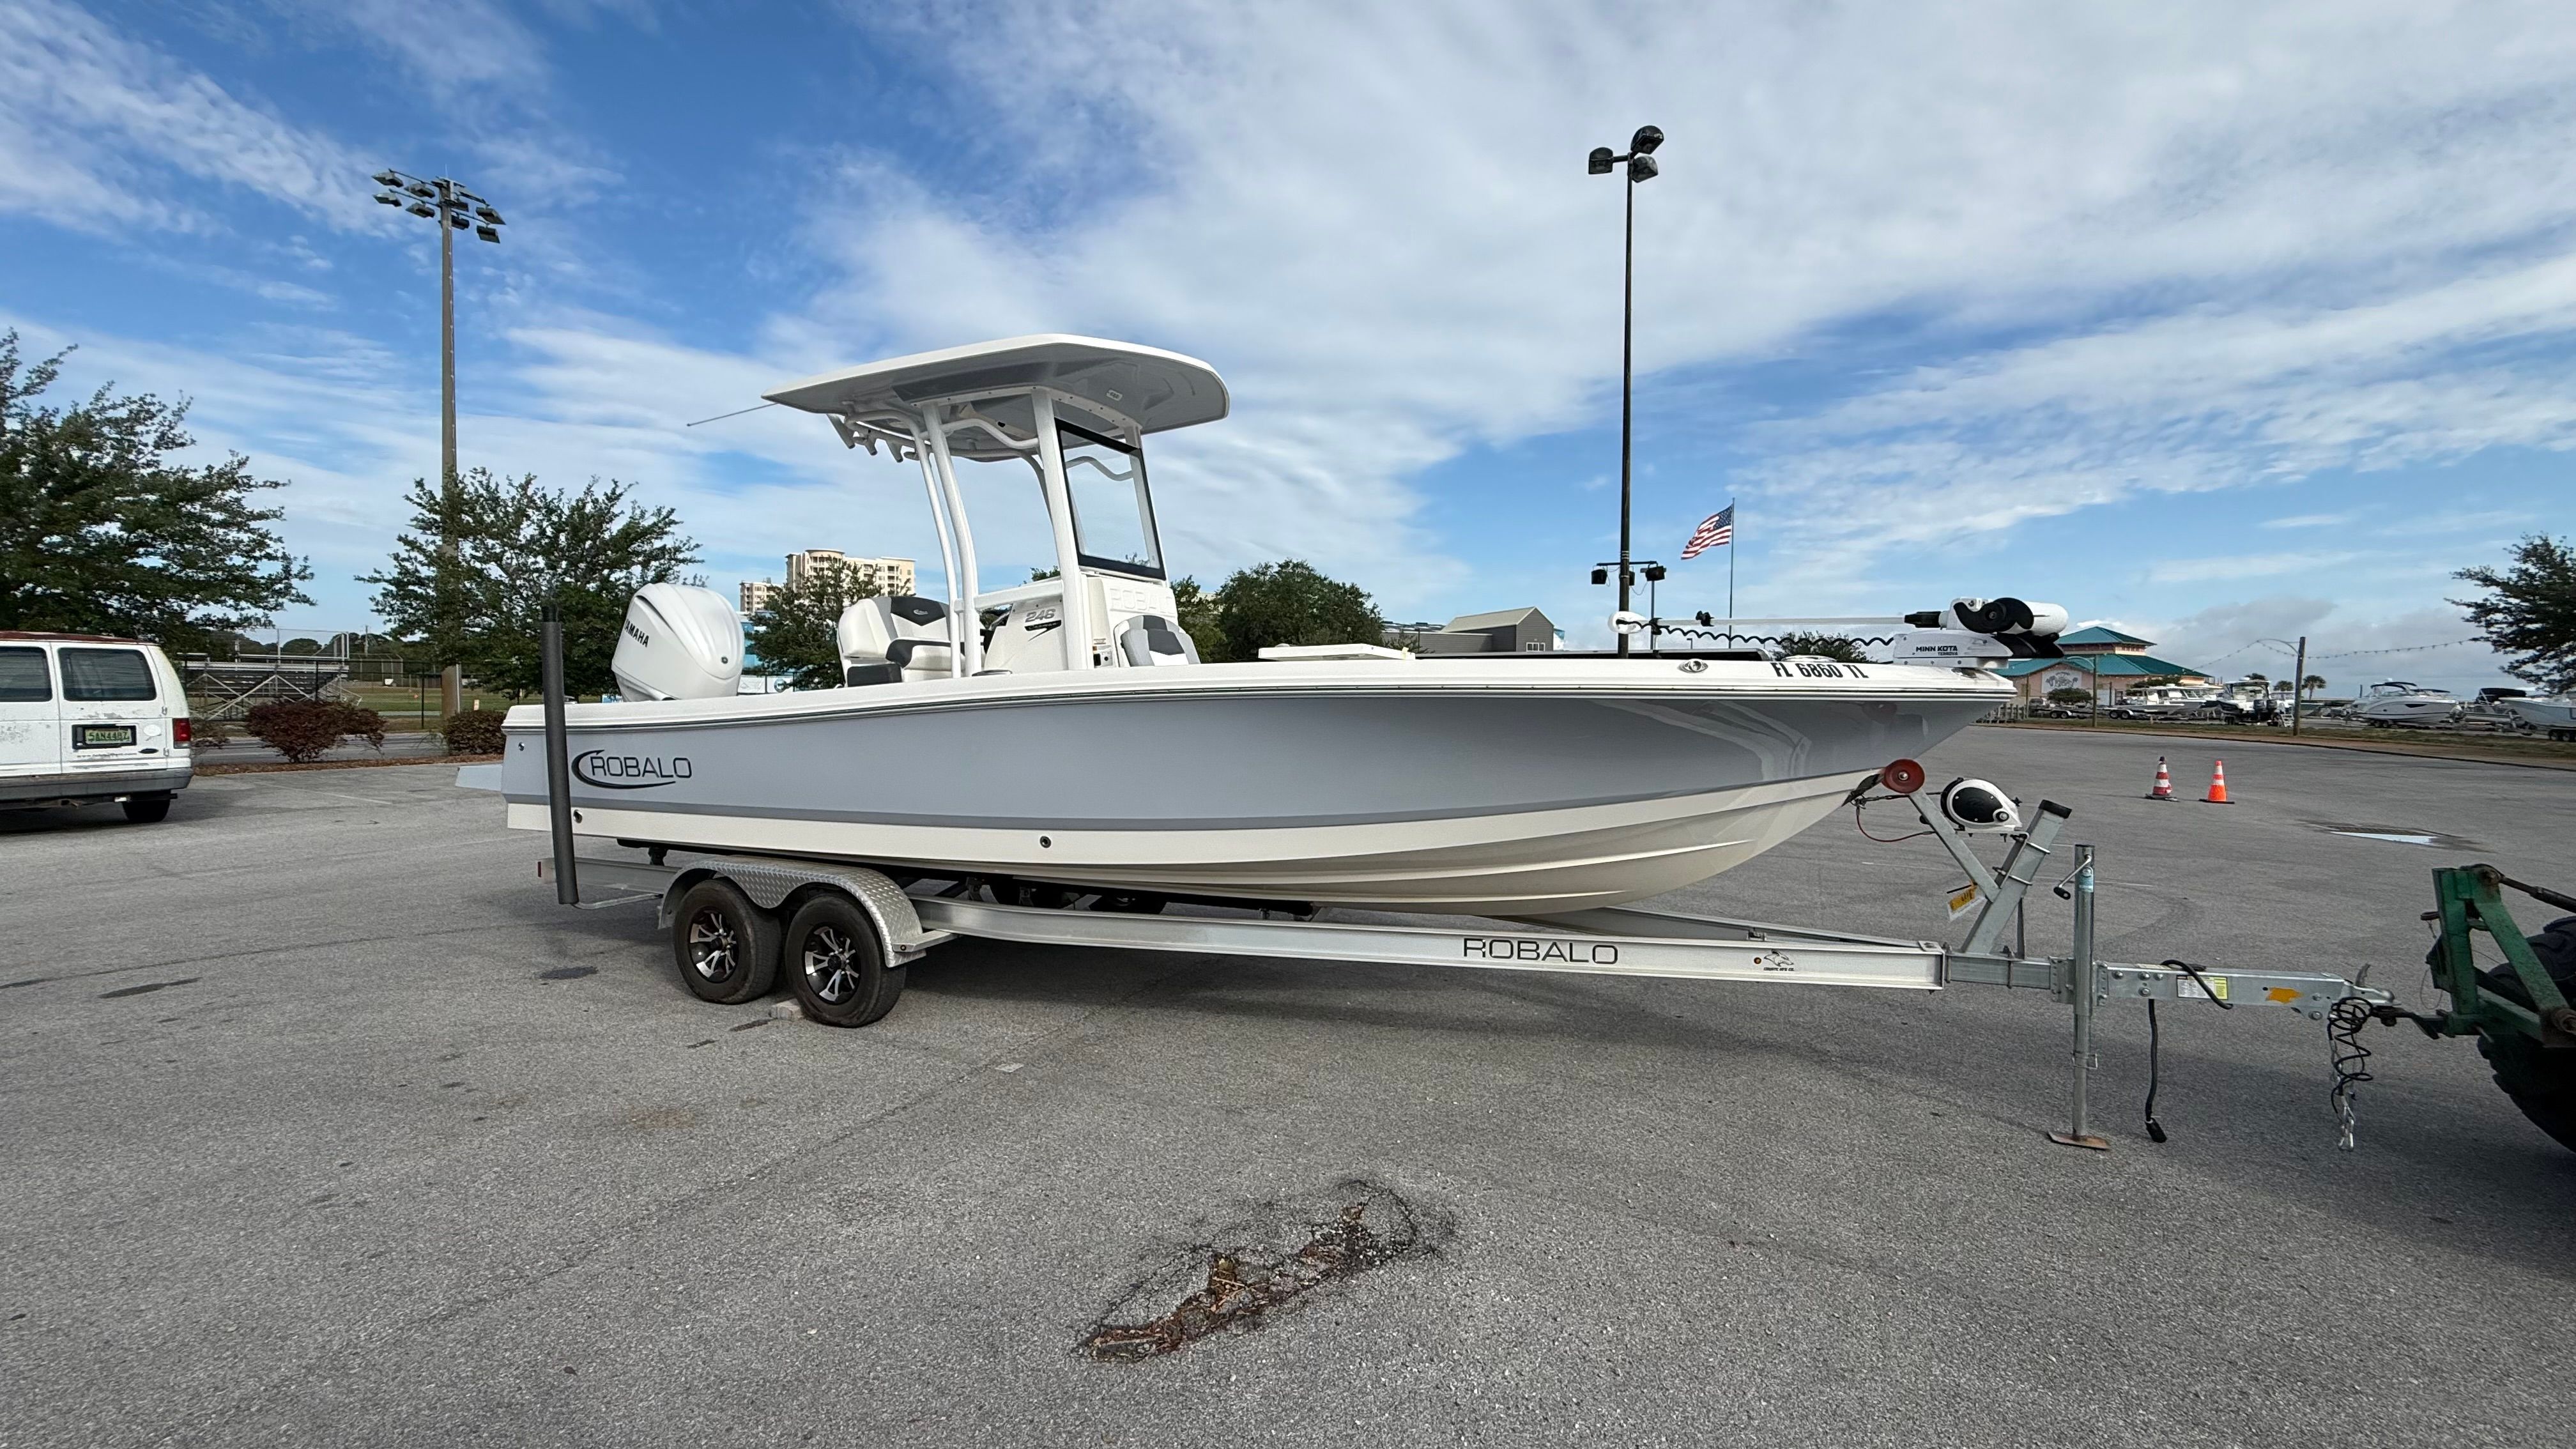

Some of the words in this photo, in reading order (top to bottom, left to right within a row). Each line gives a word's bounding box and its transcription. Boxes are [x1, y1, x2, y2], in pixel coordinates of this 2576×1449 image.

[1025, 608, 1056, 623] 246
[1770, 662, 1794, 677] FL
[1795, 663, 1844, 678] 6860
[1842, 664, 1869, 678] TL
[590, 756, 693, 779] ROBALO
[1463, 937, 1618, 965] ROBALO
